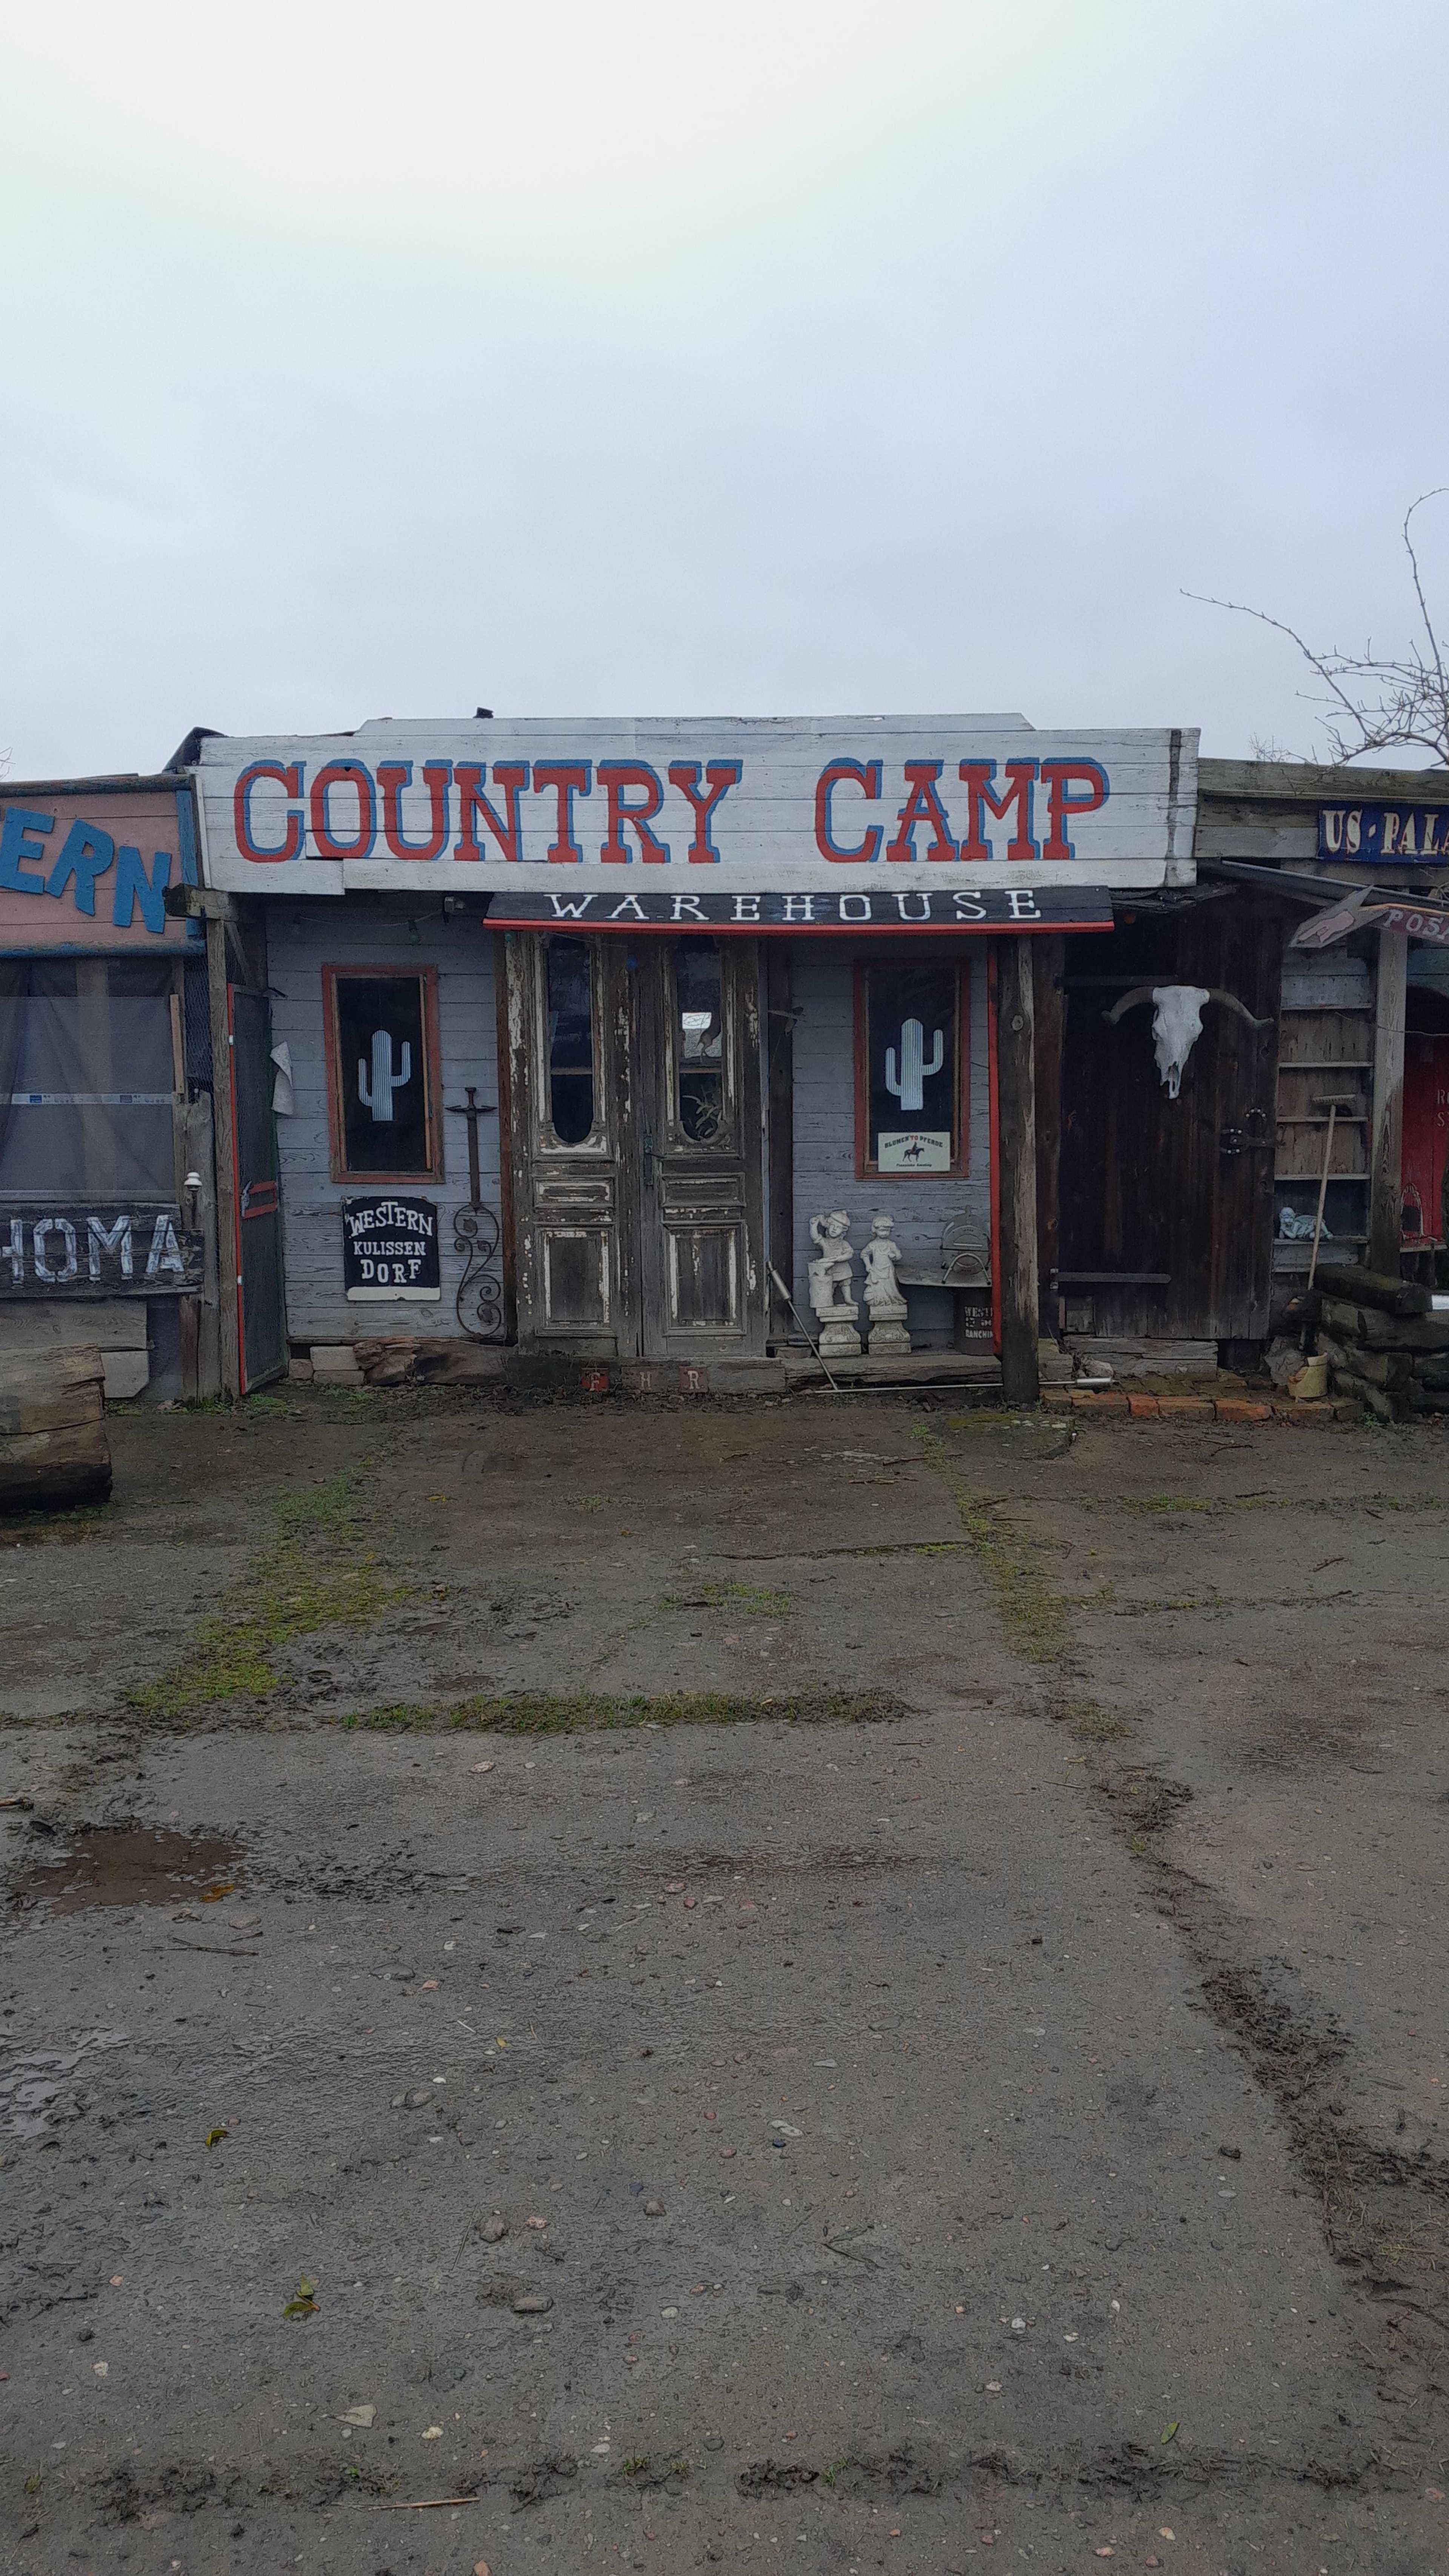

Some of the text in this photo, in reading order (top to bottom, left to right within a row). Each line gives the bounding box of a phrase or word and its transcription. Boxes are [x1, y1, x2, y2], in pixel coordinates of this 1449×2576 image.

[234, 757, 1111, 863] COUNTRY CAMP
[0, 806, 171, 934] ERN
[543, 889, 1042, 921] WAREHOUSE
[884, 1135, 910, 1148] BLUMEN
[920, 1136, 943, 1147] PFERDE
[348, 1201, 433, 1237] WESTERN
[353, 1241, 426, 1255] KULISSEN
[360, 1259, 421, 1283] DORF
[688, 1370, 700, 1389] R
